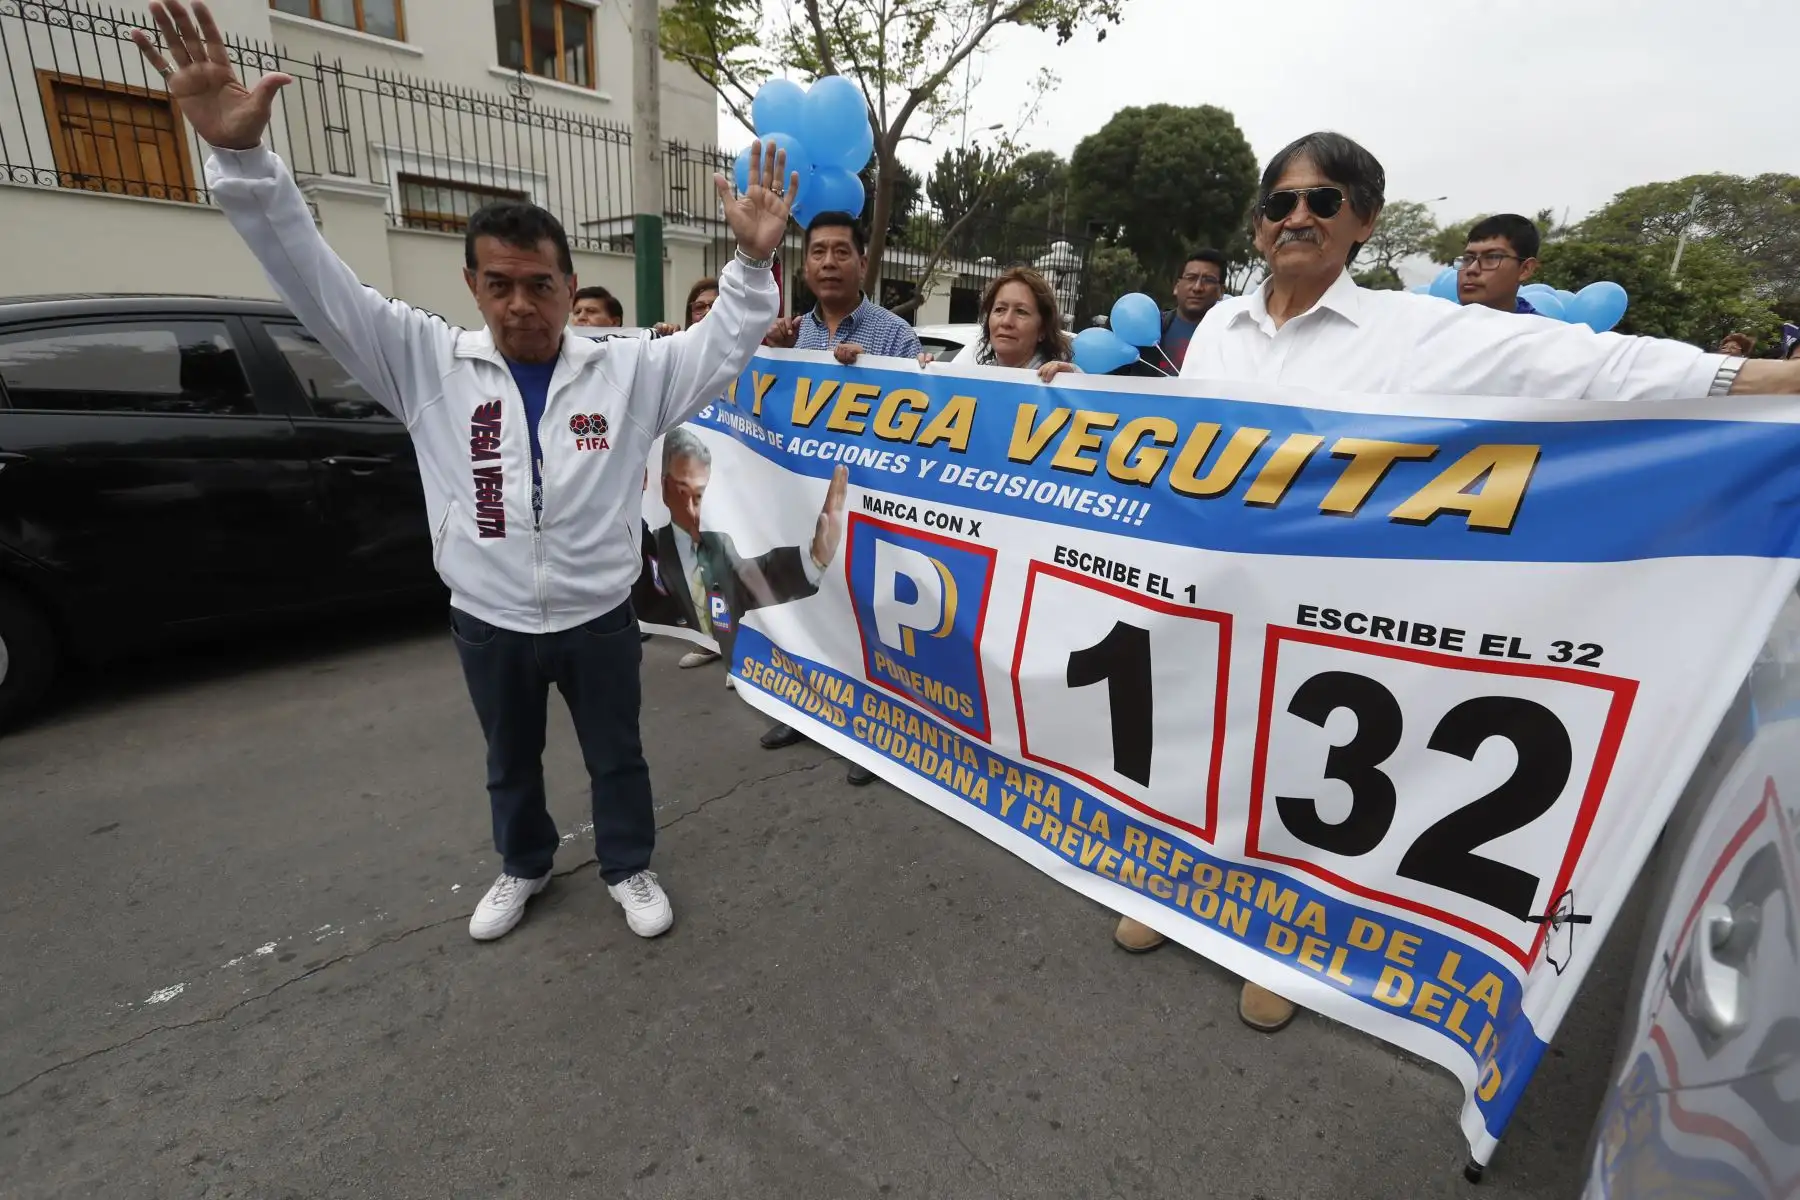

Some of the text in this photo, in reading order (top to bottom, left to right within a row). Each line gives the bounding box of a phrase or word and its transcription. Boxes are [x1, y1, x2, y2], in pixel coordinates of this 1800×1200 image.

[470, 400, 507, 539] VEGA VEGUITA
[575, 437, 610, 451] FIFA
[716, 408, 766, 442] HOMBRES
[767, 430, 784, 450] DE
[787, 437, 911, 475] ACCIONES
[918, 458, 938, 479] Y
[939, 463, 1152, 527] DECISIONES!!!
[750, 370, 776, 418] Y
[791, 377, 977, 454] VEGA
[1008, 403, 1542, 535] VEGUITA
[862, 494, 983, 538] MARCA CON X
[1052, 545, 1197, 604] ESCRIBE EL 1
[873, 650, 975, 719] PODEMOS
[1295, 603, 1605, 668] ESCRIBE EL 32
[1066, 619, 1153, 789] 1
[741, 656, 848, 728] SEGURIDAD
[853, 715, 989, 807] CIUDADANA
[999, 788, 1018, 818] Y
[1265, 924, 1353, 987] DEL
[771, 647, 1504, 1019] SON UNA GARANTÍA PARA LA REFORMA DE LA
[1275, 670, 1573, 924] 32
